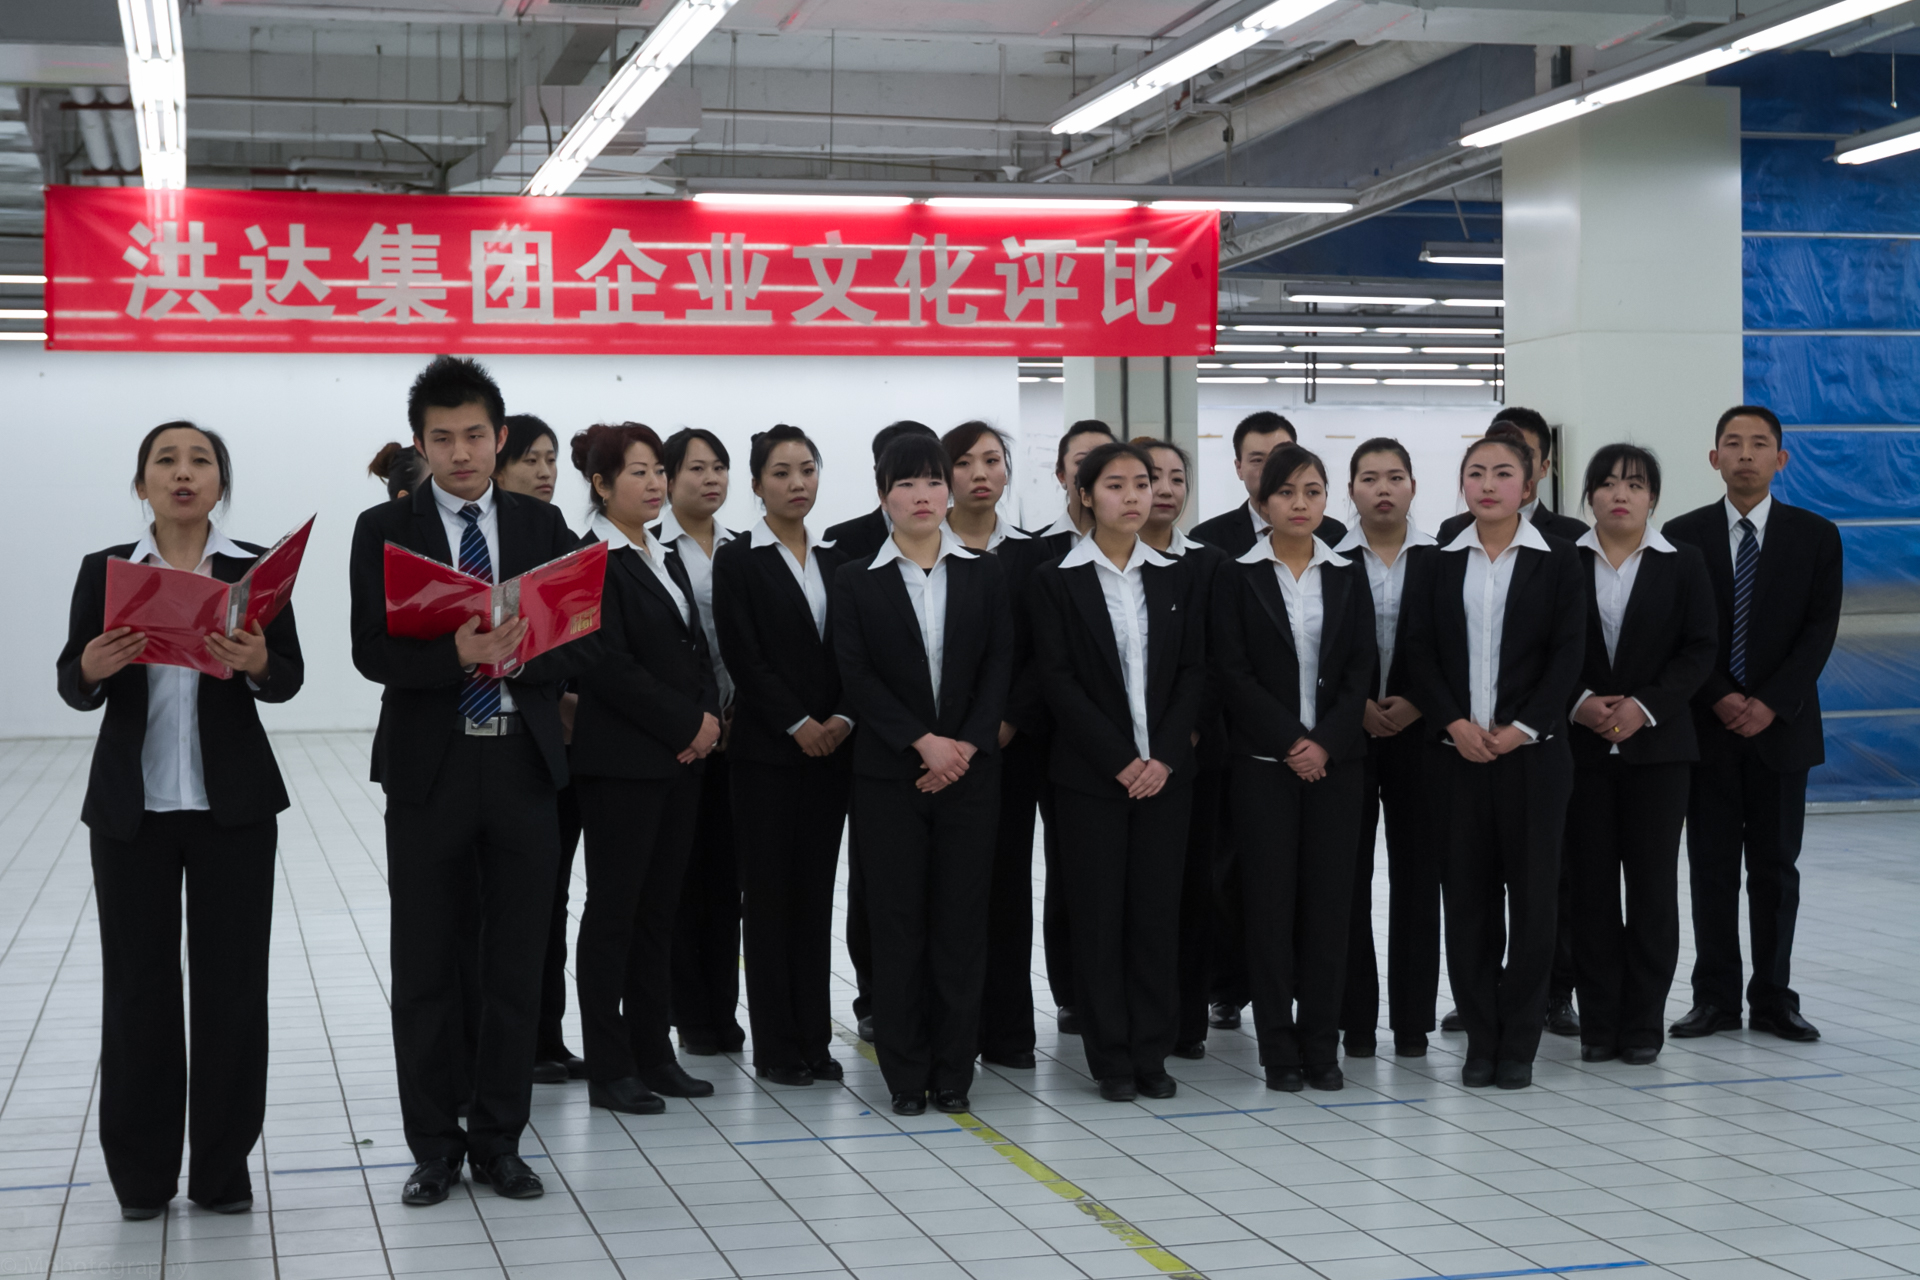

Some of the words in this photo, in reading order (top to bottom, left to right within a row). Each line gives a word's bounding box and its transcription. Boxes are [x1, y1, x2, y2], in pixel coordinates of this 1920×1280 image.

[123, 221, 1176, 327] 洪达集团企业文化评比
